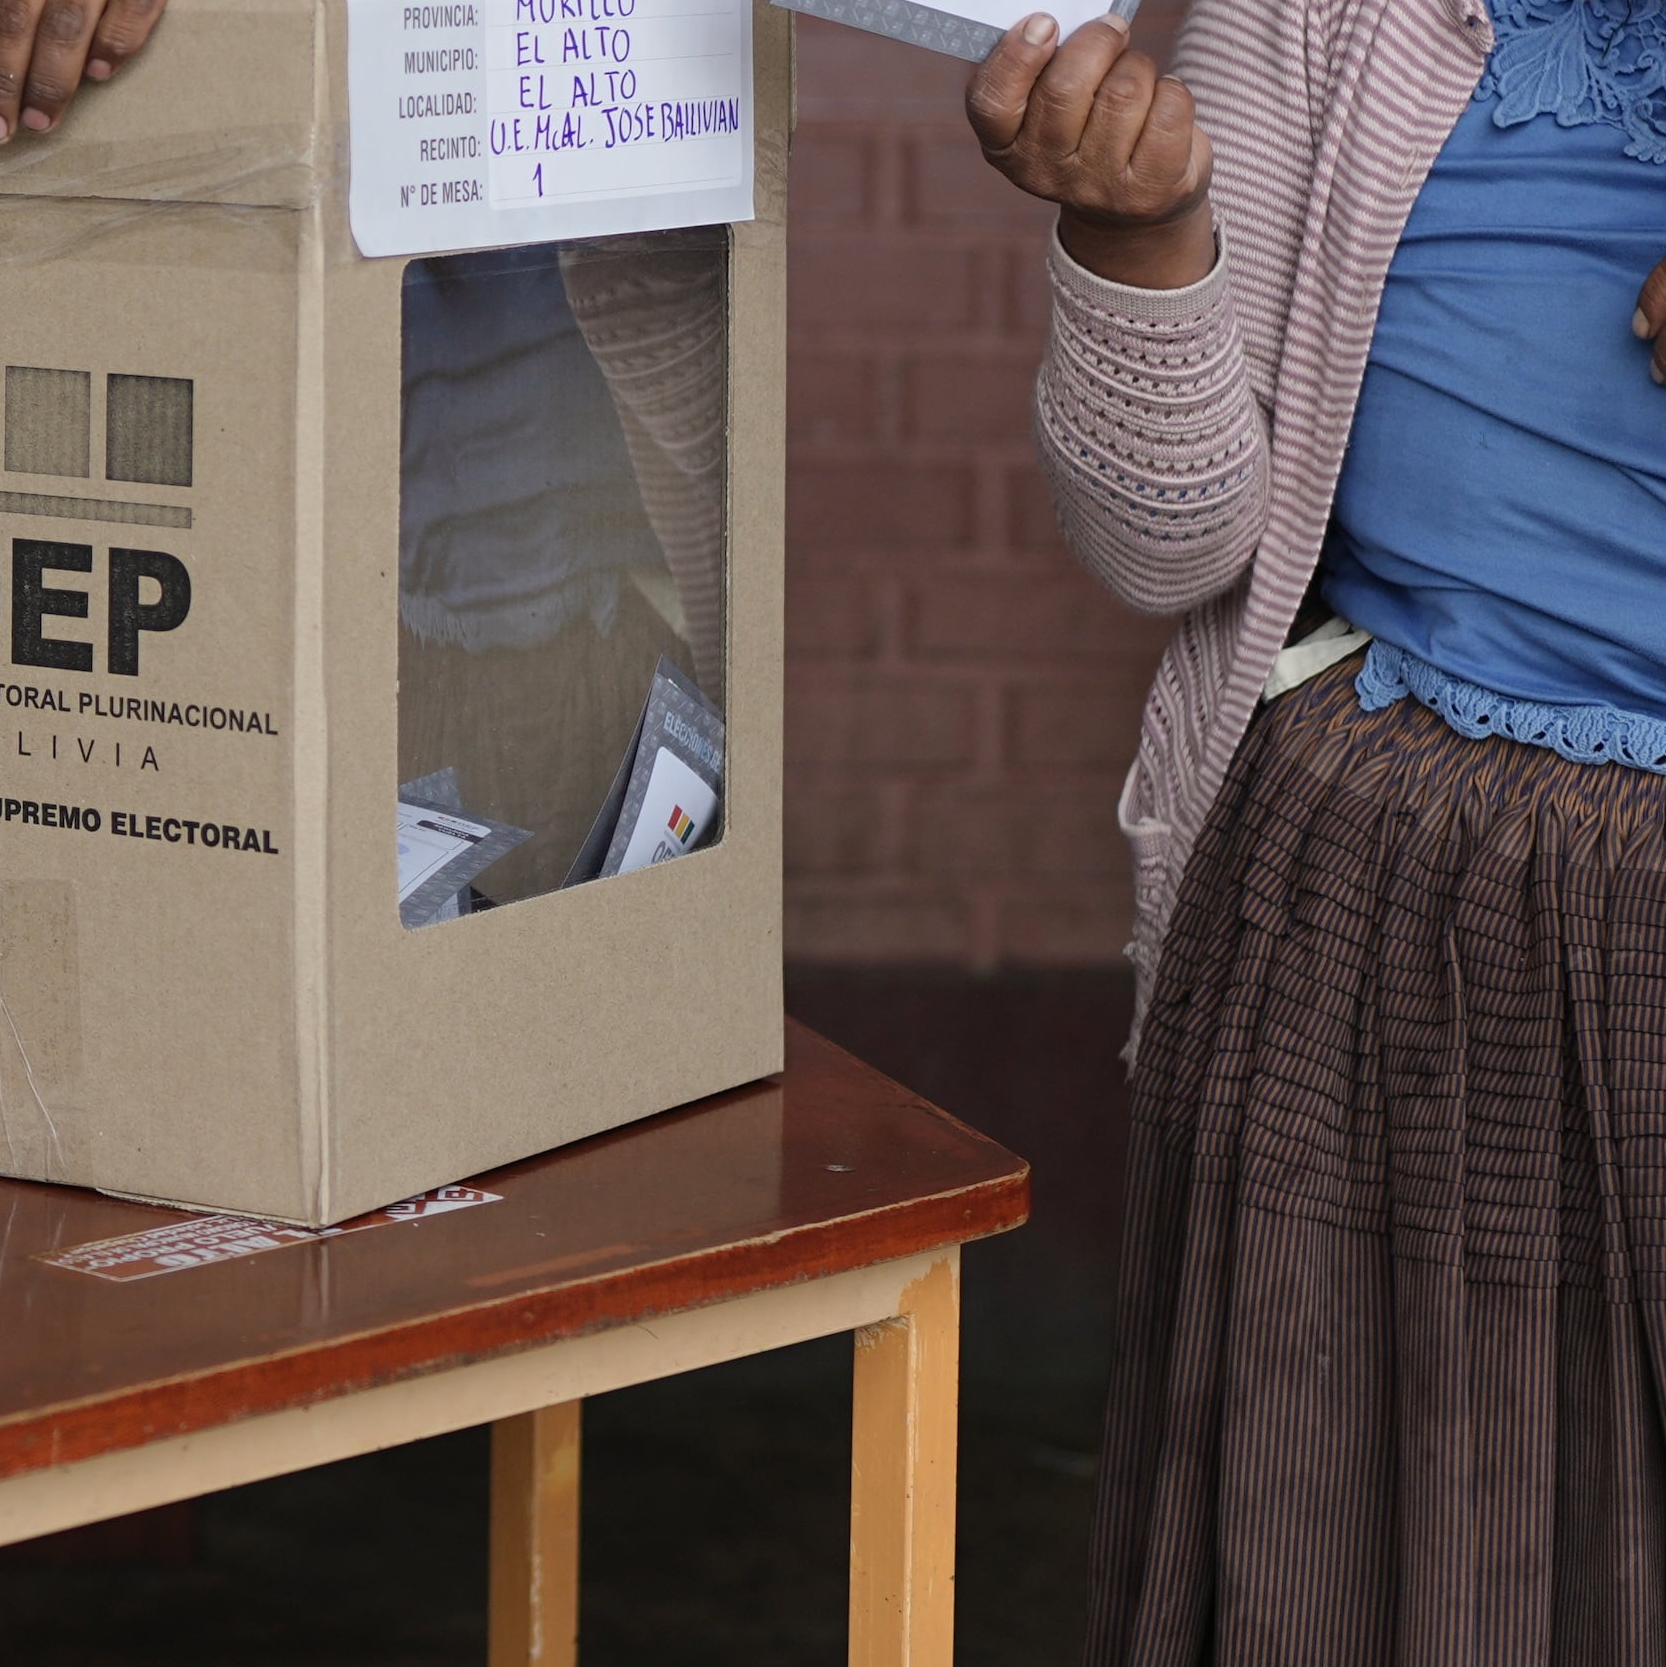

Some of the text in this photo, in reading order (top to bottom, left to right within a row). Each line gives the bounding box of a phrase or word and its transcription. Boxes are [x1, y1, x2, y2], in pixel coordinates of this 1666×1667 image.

[404, 5, 478, 30] PROVINCIA:
[404, 26, 631, 74] MUNICIPIO: EL ALTO
[398, 69, 636, 119] LOCALIDAD: EL ALTO
[420, 136, 481, 162] RECINTO:
[602, 102, 655, 149] JOSE
[421, 183, 438, 206] DE
[442, 180, 483, 204] MESA:
[532, 163, 544, 197] 1
[79, 692, 279, 736] PLURINACIONAL
[663, 711, 711, 766] ELECCIONES
[111, 812, 279, 855] ELECTORAL
[153, 1236, 281, 1267] ALTO
